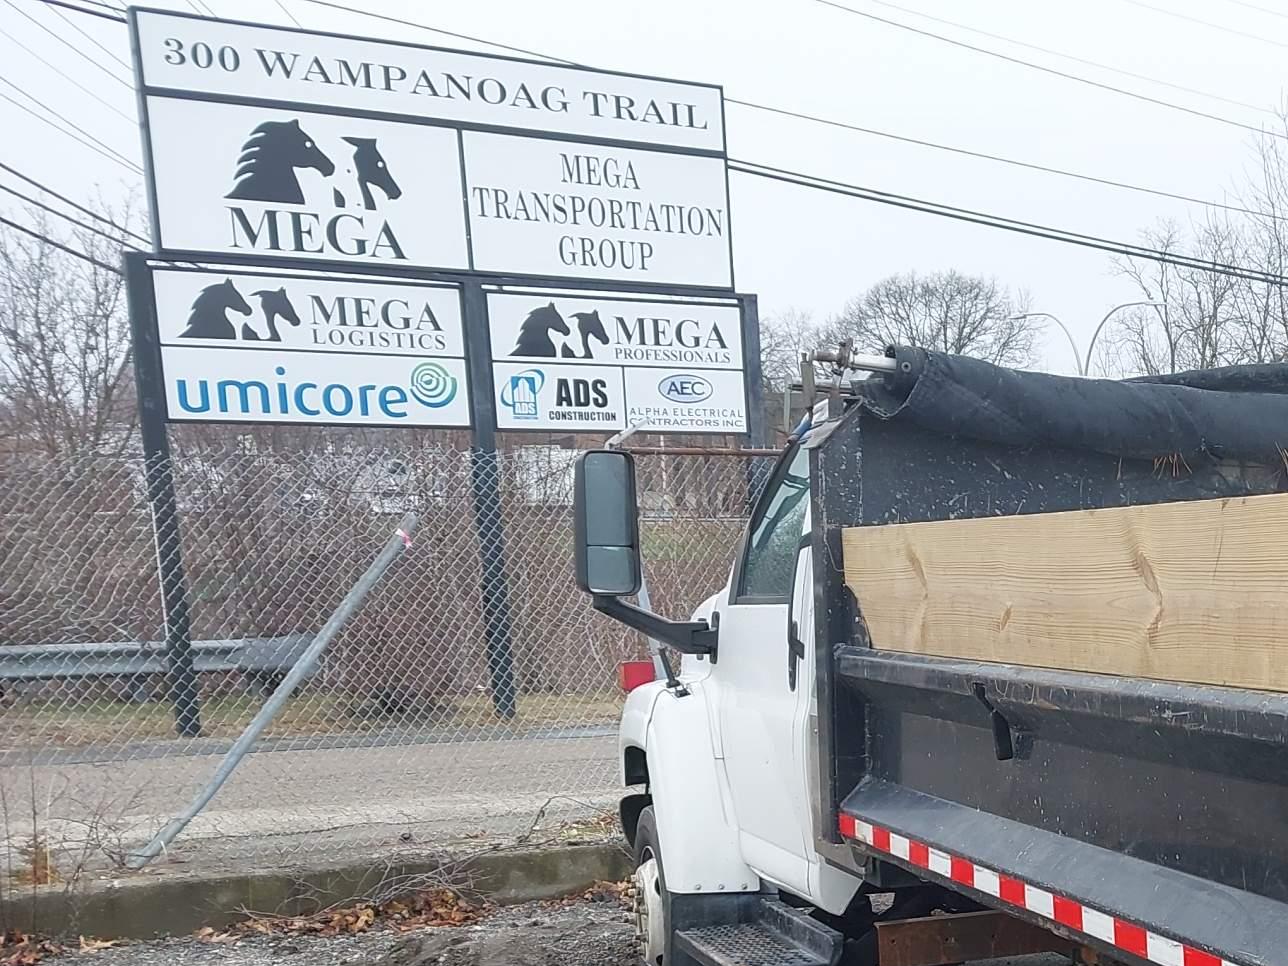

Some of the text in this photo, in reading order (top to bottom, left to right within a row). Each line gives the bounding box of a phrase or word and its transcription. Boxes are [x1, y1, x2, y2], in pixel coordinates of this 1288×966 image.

[163, 38, 709, 131] 300 WAMPANOAG TRAIL
[559, 153, 641, 191] MEGA
[472, 186, 724, 237] TRANSPORTATION
[226, 205, 410, 260] MEGA
[558, 235, 654, 271] GROUP
[308, 294, 444, 331] MEGA
[312, 328, 446, 350] LOGISTICS
[613, 316, 728, 349] MEGA
[615, 348, 731, 363] PROFESSIONALS
[175, 366, 408, 418] umicore
[556, 378, 608, 408] ADS
[667, 380, 706, 396] AEC
[548, 410, 617, 422] CONSTRUCTION
[629, 407, 744, 418] ALPHA ELECTRICAL
